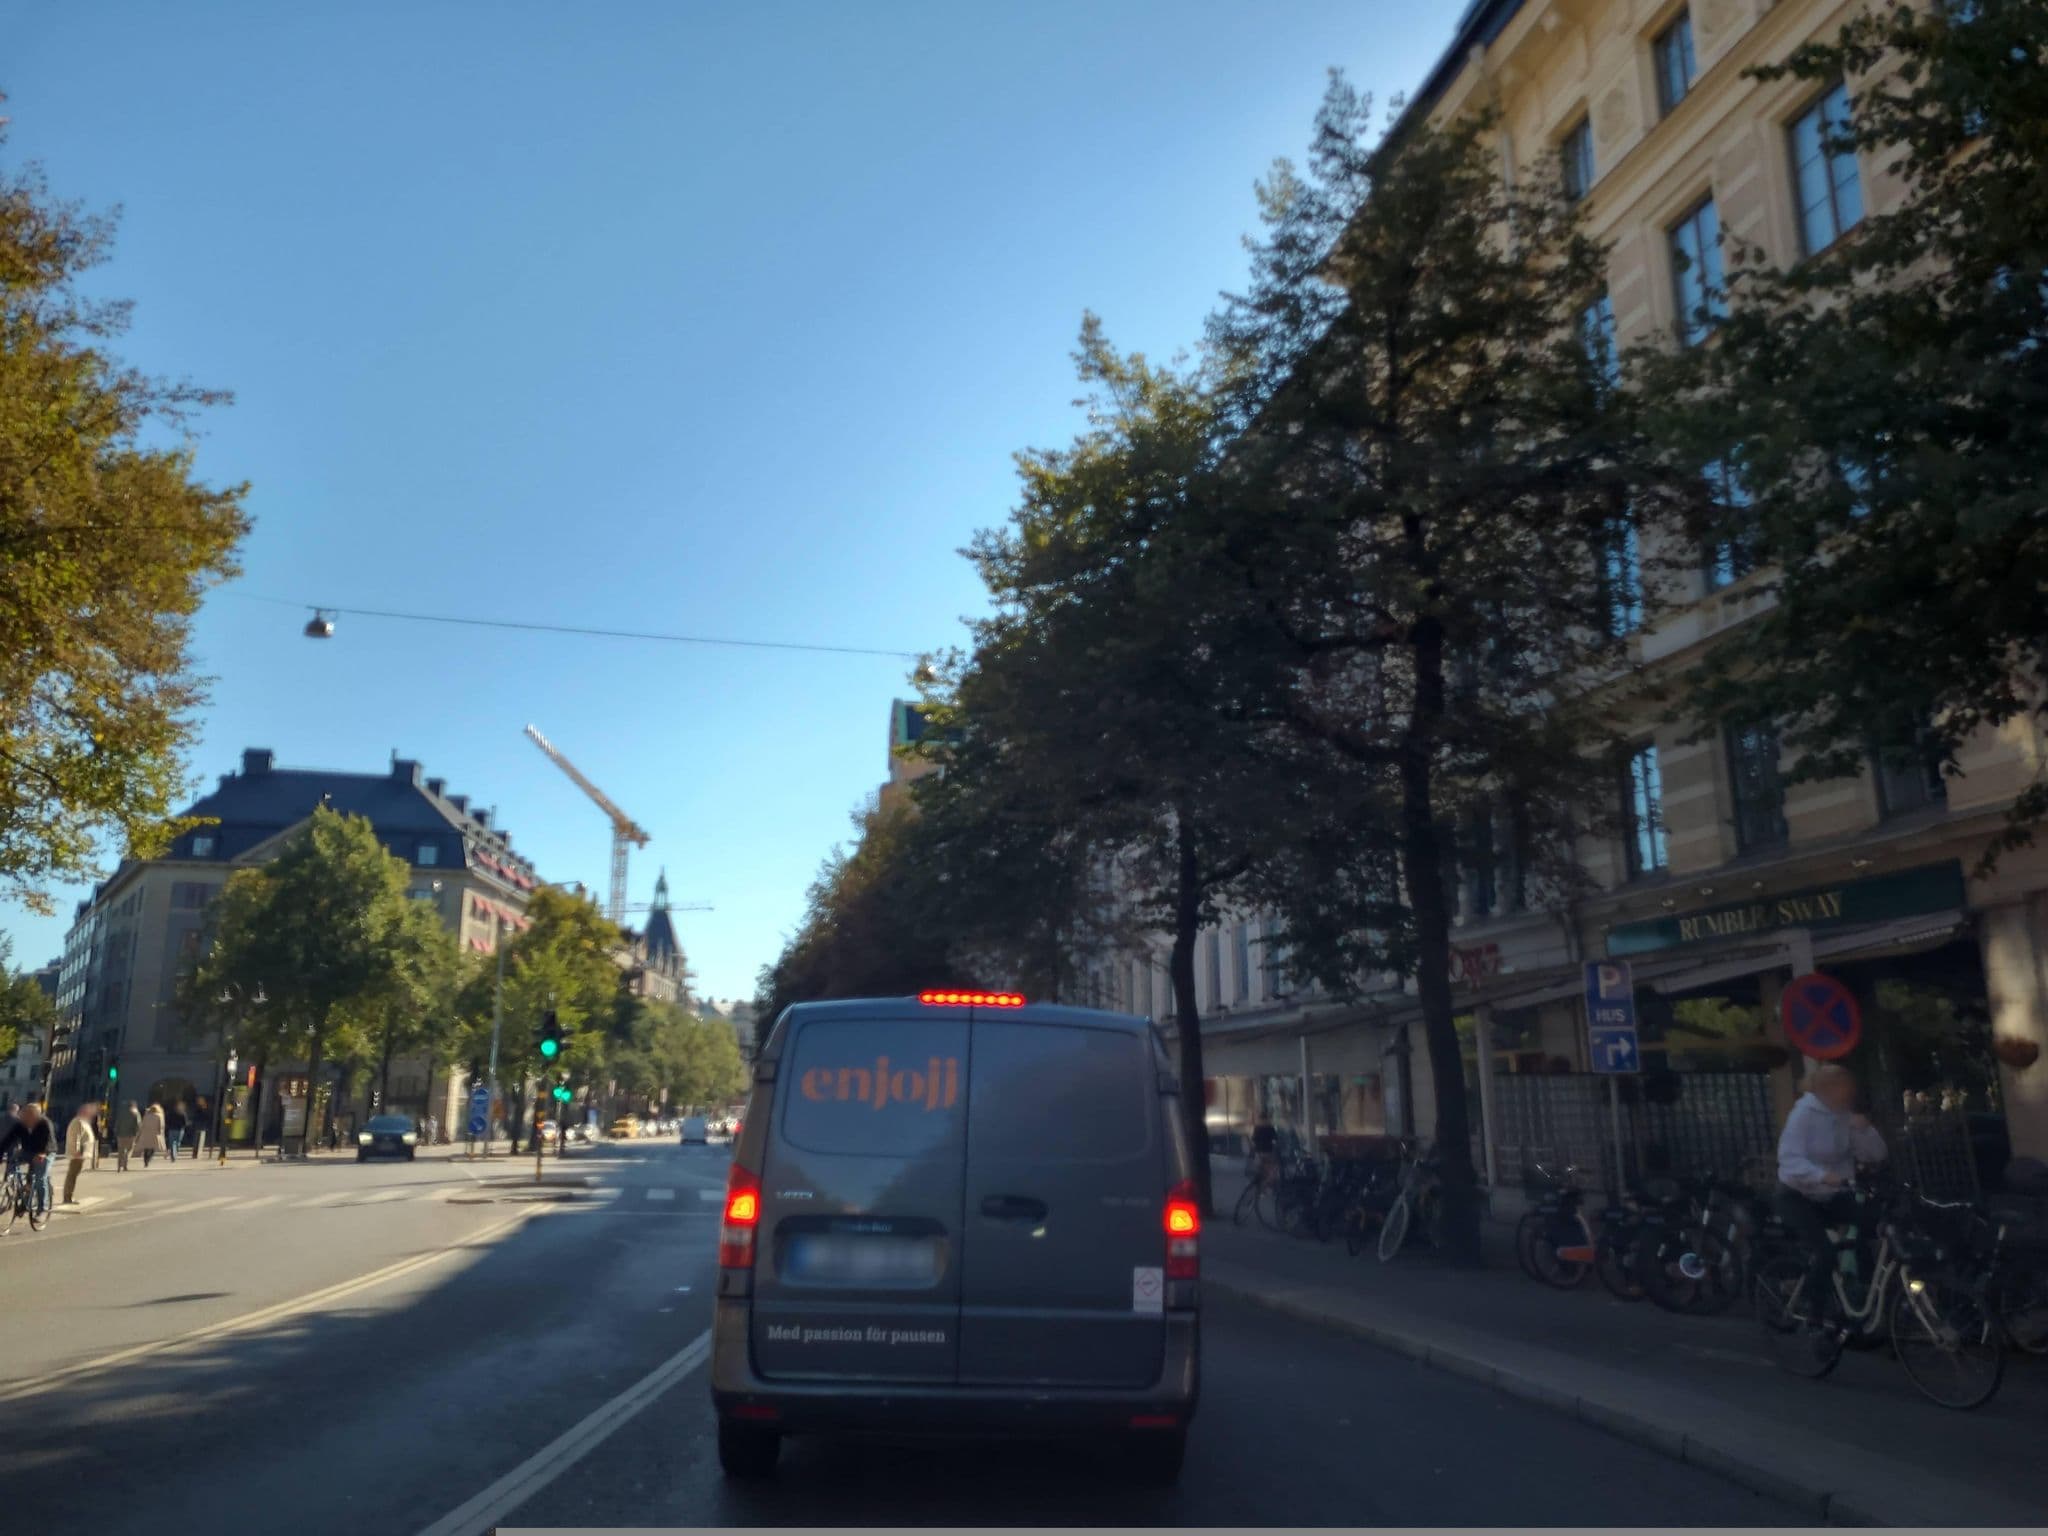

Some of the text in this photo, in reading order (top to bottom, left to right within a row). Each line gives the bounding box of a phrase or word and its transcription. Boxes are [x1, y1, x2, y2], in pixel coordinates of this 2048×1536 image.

[1597, 965, 1621, 999] P
[1595, 1008, 1626, 1023] HUS
[767, 1324, 945, 1345] Med passion för pausen
